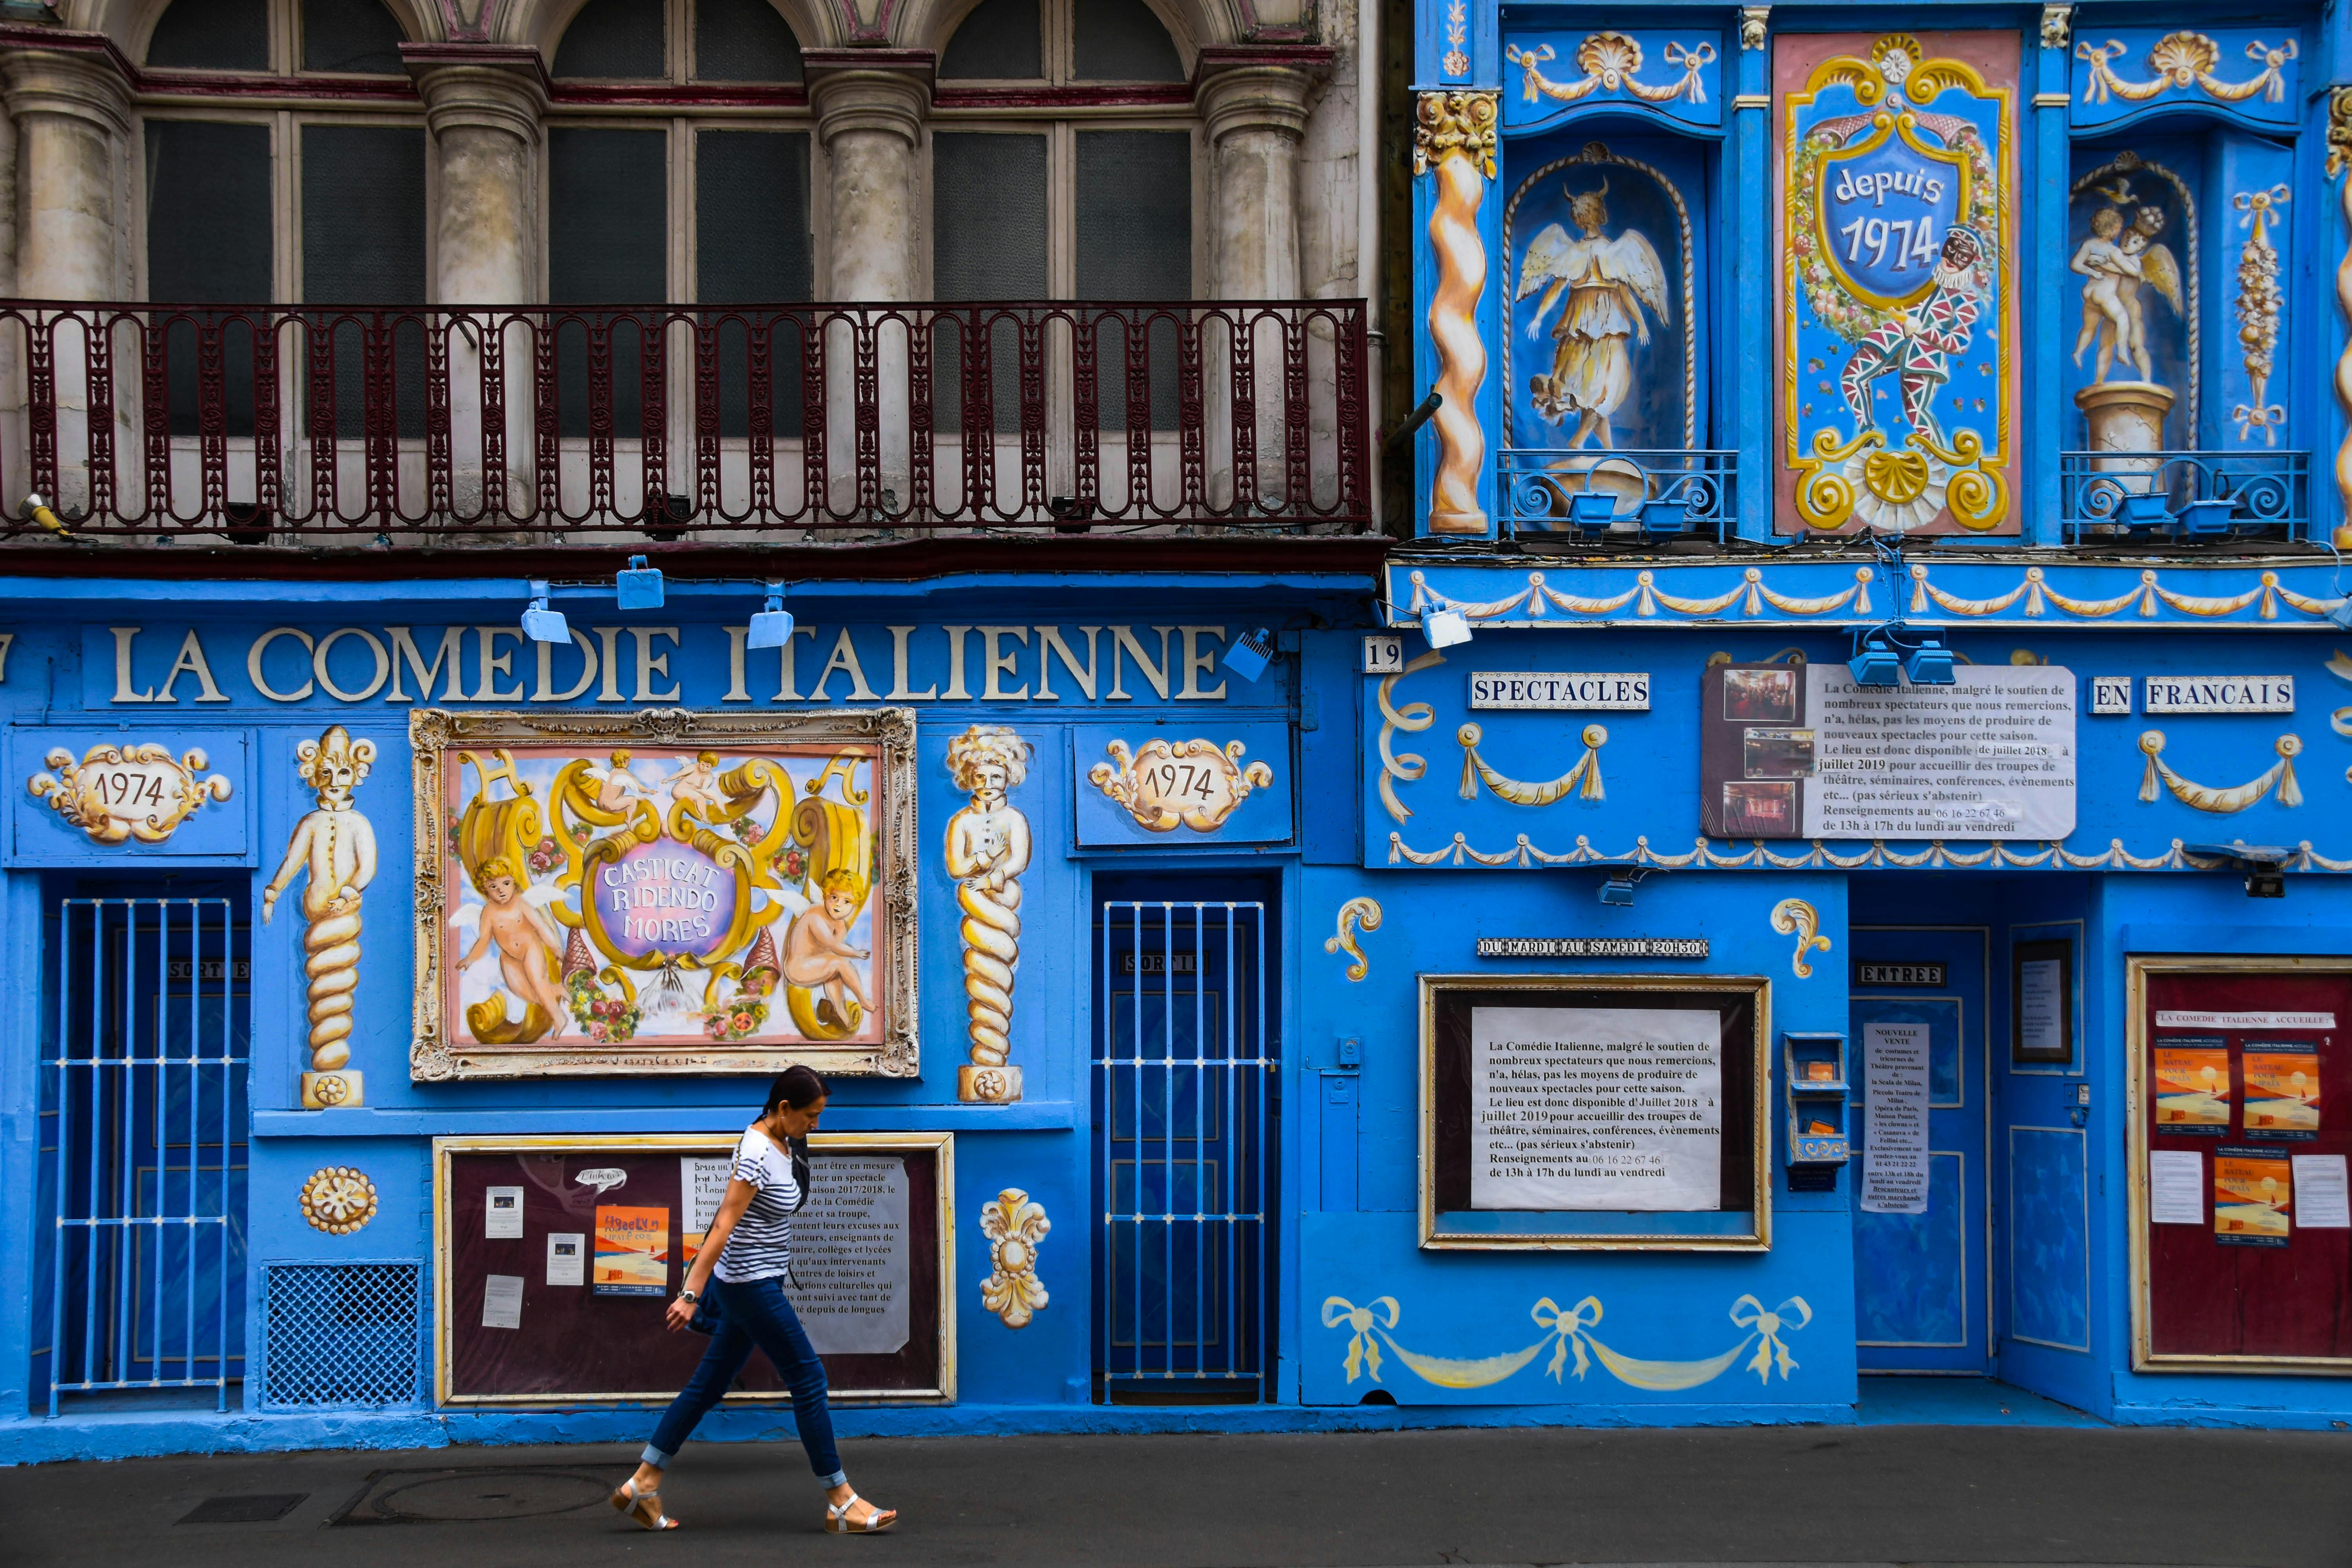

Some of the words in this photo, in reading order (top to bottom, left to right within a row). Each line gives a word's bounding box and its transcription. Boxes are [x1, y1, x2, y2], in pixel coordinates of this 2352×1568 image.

[1835, 169, 1944, 205] depuis
[1840, 216, 1939, 268] 1974
[1369, 644, 1399, 665] 19
[110, 627, 230, 702] LA
[247, 626, 680, 702] COMEDIE
[722, 625, 1226, 701] ITALIENNE
[1474, 680, 1648, 702] SPECTACLES
[2095, 684, 2129, 705] EN
[2148, 684, 2290, 705] FRANCAIS
[1825, 699, 1881, 709] nombreux
[1885, 701, 1948, 711] spectateurs
[1952, 702, 1972, 712] que
[2005, 701, 2071, 711] remercions,
[1145, 764, 1214, 801] 1974
[1824, 775, 1866, 786] théâtre,
[1870, 775, 1933, 786] séminaires,
[1936, 776, 2005, 786] conférences,
[2009, 776, 2074, 786] évènements
[94, 773, 165, 806] 1974
[1823, 820, 1836, 830] de
[1840, 820, 1859, 830] 13h
[1864, 820, 1869, 830] à
[1875, 821, 1893, 831] 17h
[1897, 821, 1911, 831] du
[1916, 821, 1944, 831] lundi
[1965, 822, 2014, 831] vendredi
[604, 858, 720, 887] CASTIGAT
[612, 886, 718, 912] RIDENDO
[622, 915, 710, 942] MORES
[1484, 942, 1499, 952] DU
[1510, 942, 1552, 952] MARDI
[1564, 942, 1581, 952] AU
[1593, 942, 1642, 952] SAMEDI
[1655, 943, 1697, 953] 20H30
[169, 962, 247, 977] SORTE
[1864, 967, 1939, 982] ENTREE
[1490, 1042, 1502, 1051] La
[1506, 1042, 1551, 1051] Comédie
[1555, 1042, 1603, 1052] Italienne,
[1607, 1042, 1642, 1053] malgré
[1646, 1042, 1654, 1051] le
[1658, 1042, 1694, 1051] soutien
[1698, 1042, 1709, 1051] de
[1490, 1056, 1541, 1065] nombreux
[1545, 1057, 1602, 1067] spectateurs
[1606, 1058, 1624, 1067] que
[1656, 1056, 1715, 1066] remercions,
[1542, 1084, 1592, 1095] spectacles
[1596, 1085, 1620, 1095] pour
[1651, 1084, 1685, 1093] saison.
[1481, 1111, 1516, 1123] juillet
[1521, 1111, 1548, 1122] 2019
[1550, 1114, 1574, 1123] pour
[1577, 1112, 1624, 1120] accueillir
[1628, 1112, 1644, 1120] des
[1648, 1110, 1686, 1123] troupes
[1690, 1111, 1702, 1120] de
[1516, 1140, 1537, 1151] (pas
[1541, 1140, 1577, 1149] sérieux
[1581, 1140, 1634, 1150] s'abstenir)
[1490, 1154, 1572, 1165] Renseignements
[1593, 1155, 1603, 1164] 06
[1608, 1155, 1618, 1164] 16
[1635, 1156, 1646, 1164] 67
[1649, 1156, 1661, 1164] 46
[846, 1174, 885, 1183] spectacle
[838, 1186, 885, 1194] 2017/2018,
[835, 1197, 874, 1205] Comédie
[829, 1234, 880, 1243] enseignants
[818, 1245, 851, 1255] collèges
[866, 1245, 891, 1255] lycées
[797, 1258, 827, 1267] qu'aux
[878, 1281, 891, 1291] qui
[807, 1305, 835, 1315] depuis
[852, 1305, 884, 1315] longues
